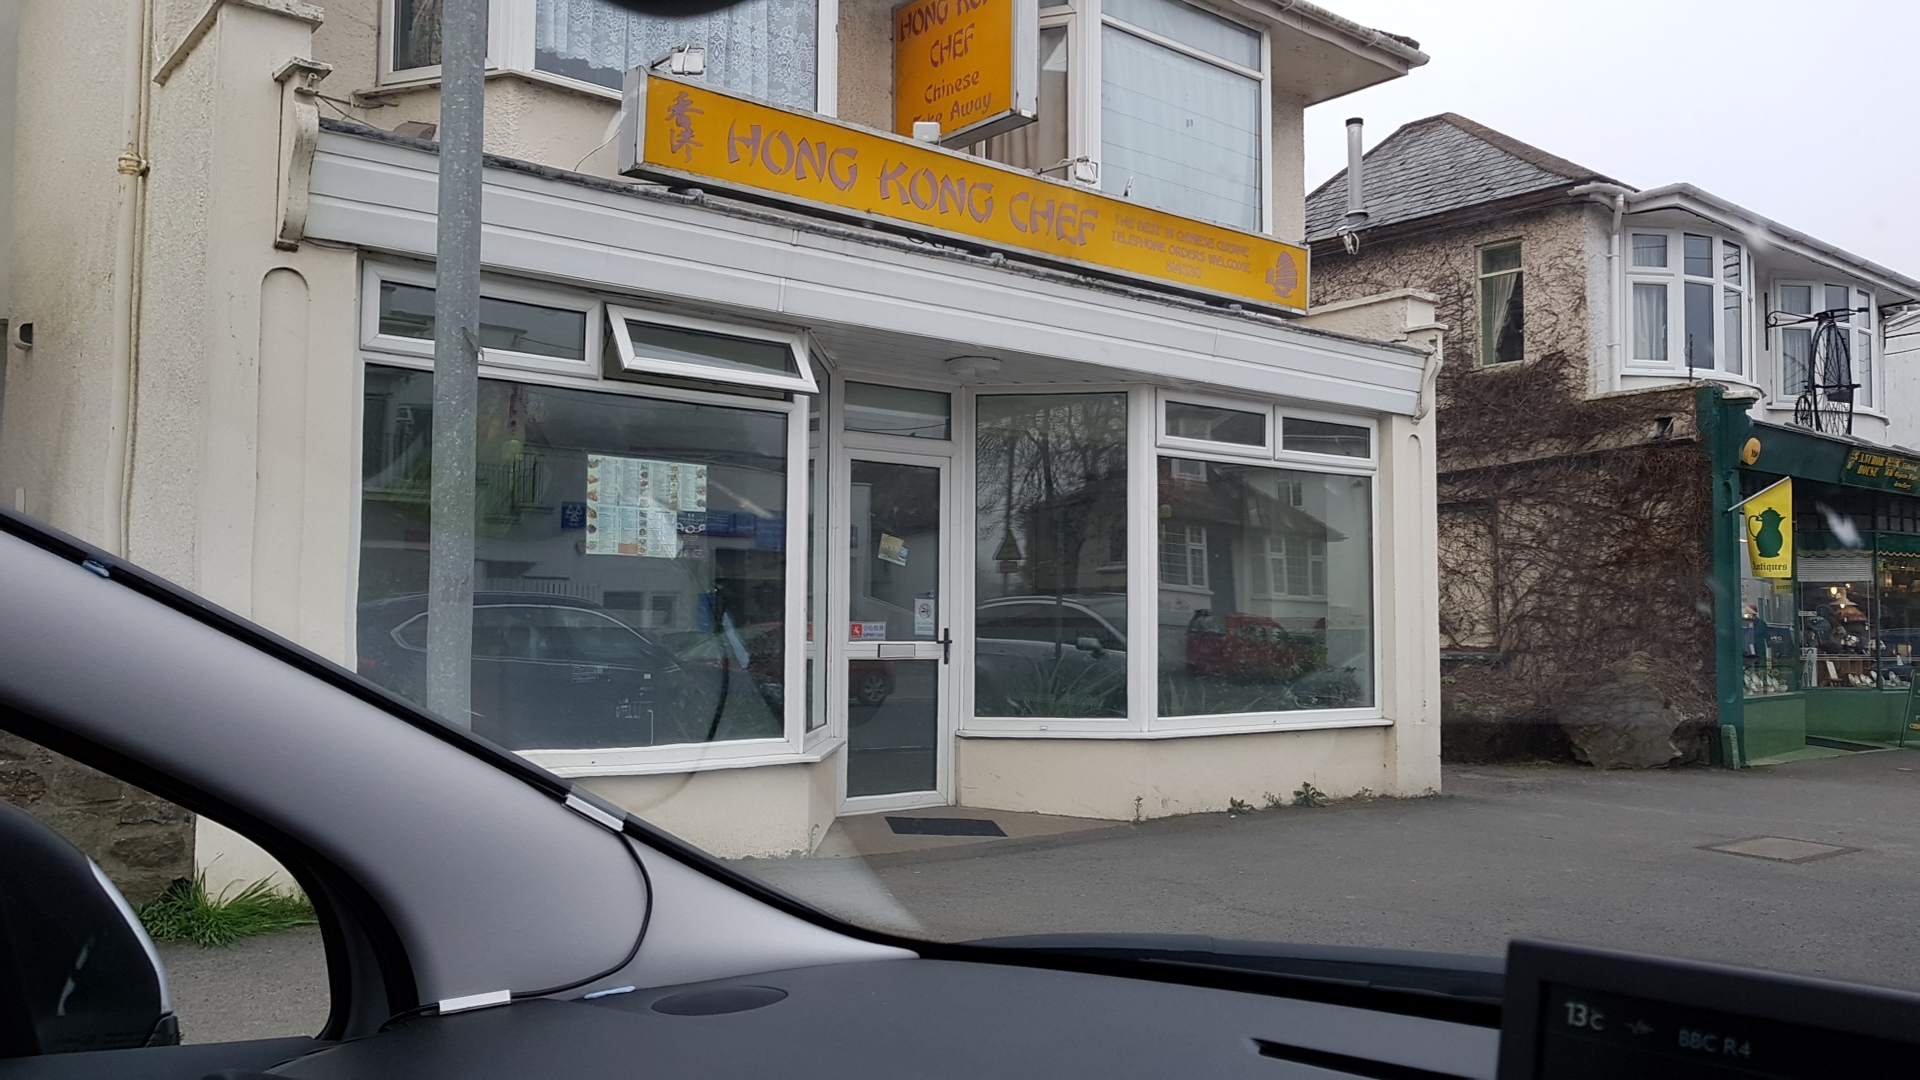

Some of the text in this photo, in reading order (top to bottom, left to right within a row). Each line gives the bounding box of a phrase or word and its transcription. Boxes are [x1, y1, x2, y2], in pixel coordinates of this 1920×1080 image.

[900, 0, 948, 42] HONG
[930, 23, 975, 68] CHEF
[924, 71, 980, 104] Chinese
[950, 92, 992, 122] Away
[727, 120, 1099, 246] HONG KONG CHEF
[1115, 214, 1135, 229] THE
[1137, 219, 1162, 235] BEST
[1177, 230, 1215, 250] CHINESE
[1112, 229, 1251, 273] TELEPHONE ORDERS WELCOME
[1752, 561, 1788, 573] Antiques
[1678, 1029, 1718, 1053] BBC
[1723, 1036, 1752, 1058] R4
